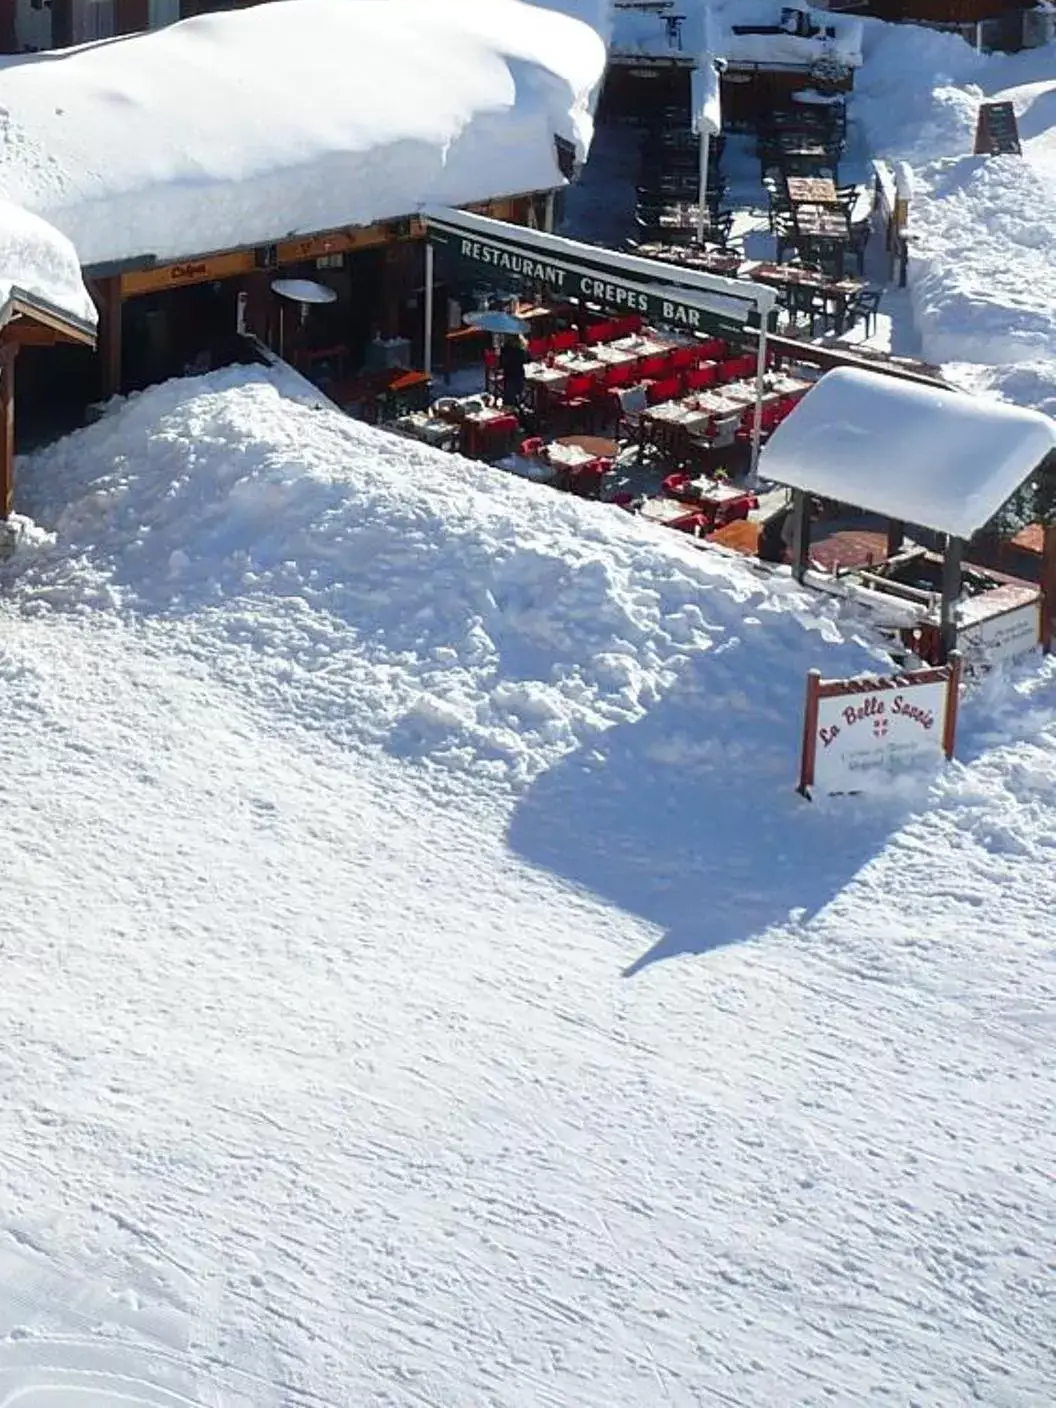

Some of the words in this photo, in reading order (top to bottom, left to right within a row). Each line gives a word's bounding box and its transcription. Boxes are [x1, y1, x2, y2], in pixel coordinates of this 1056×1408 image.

[461, 239, 566, 286] RESTAURANT
[580, 277, 648, 311] CREPES
[662, 301, 701, 326] BAR
[818, 724, 840, 747] La
[842, 696, 885, 725] Belle
[890, 695, 934, 729] Savoie
